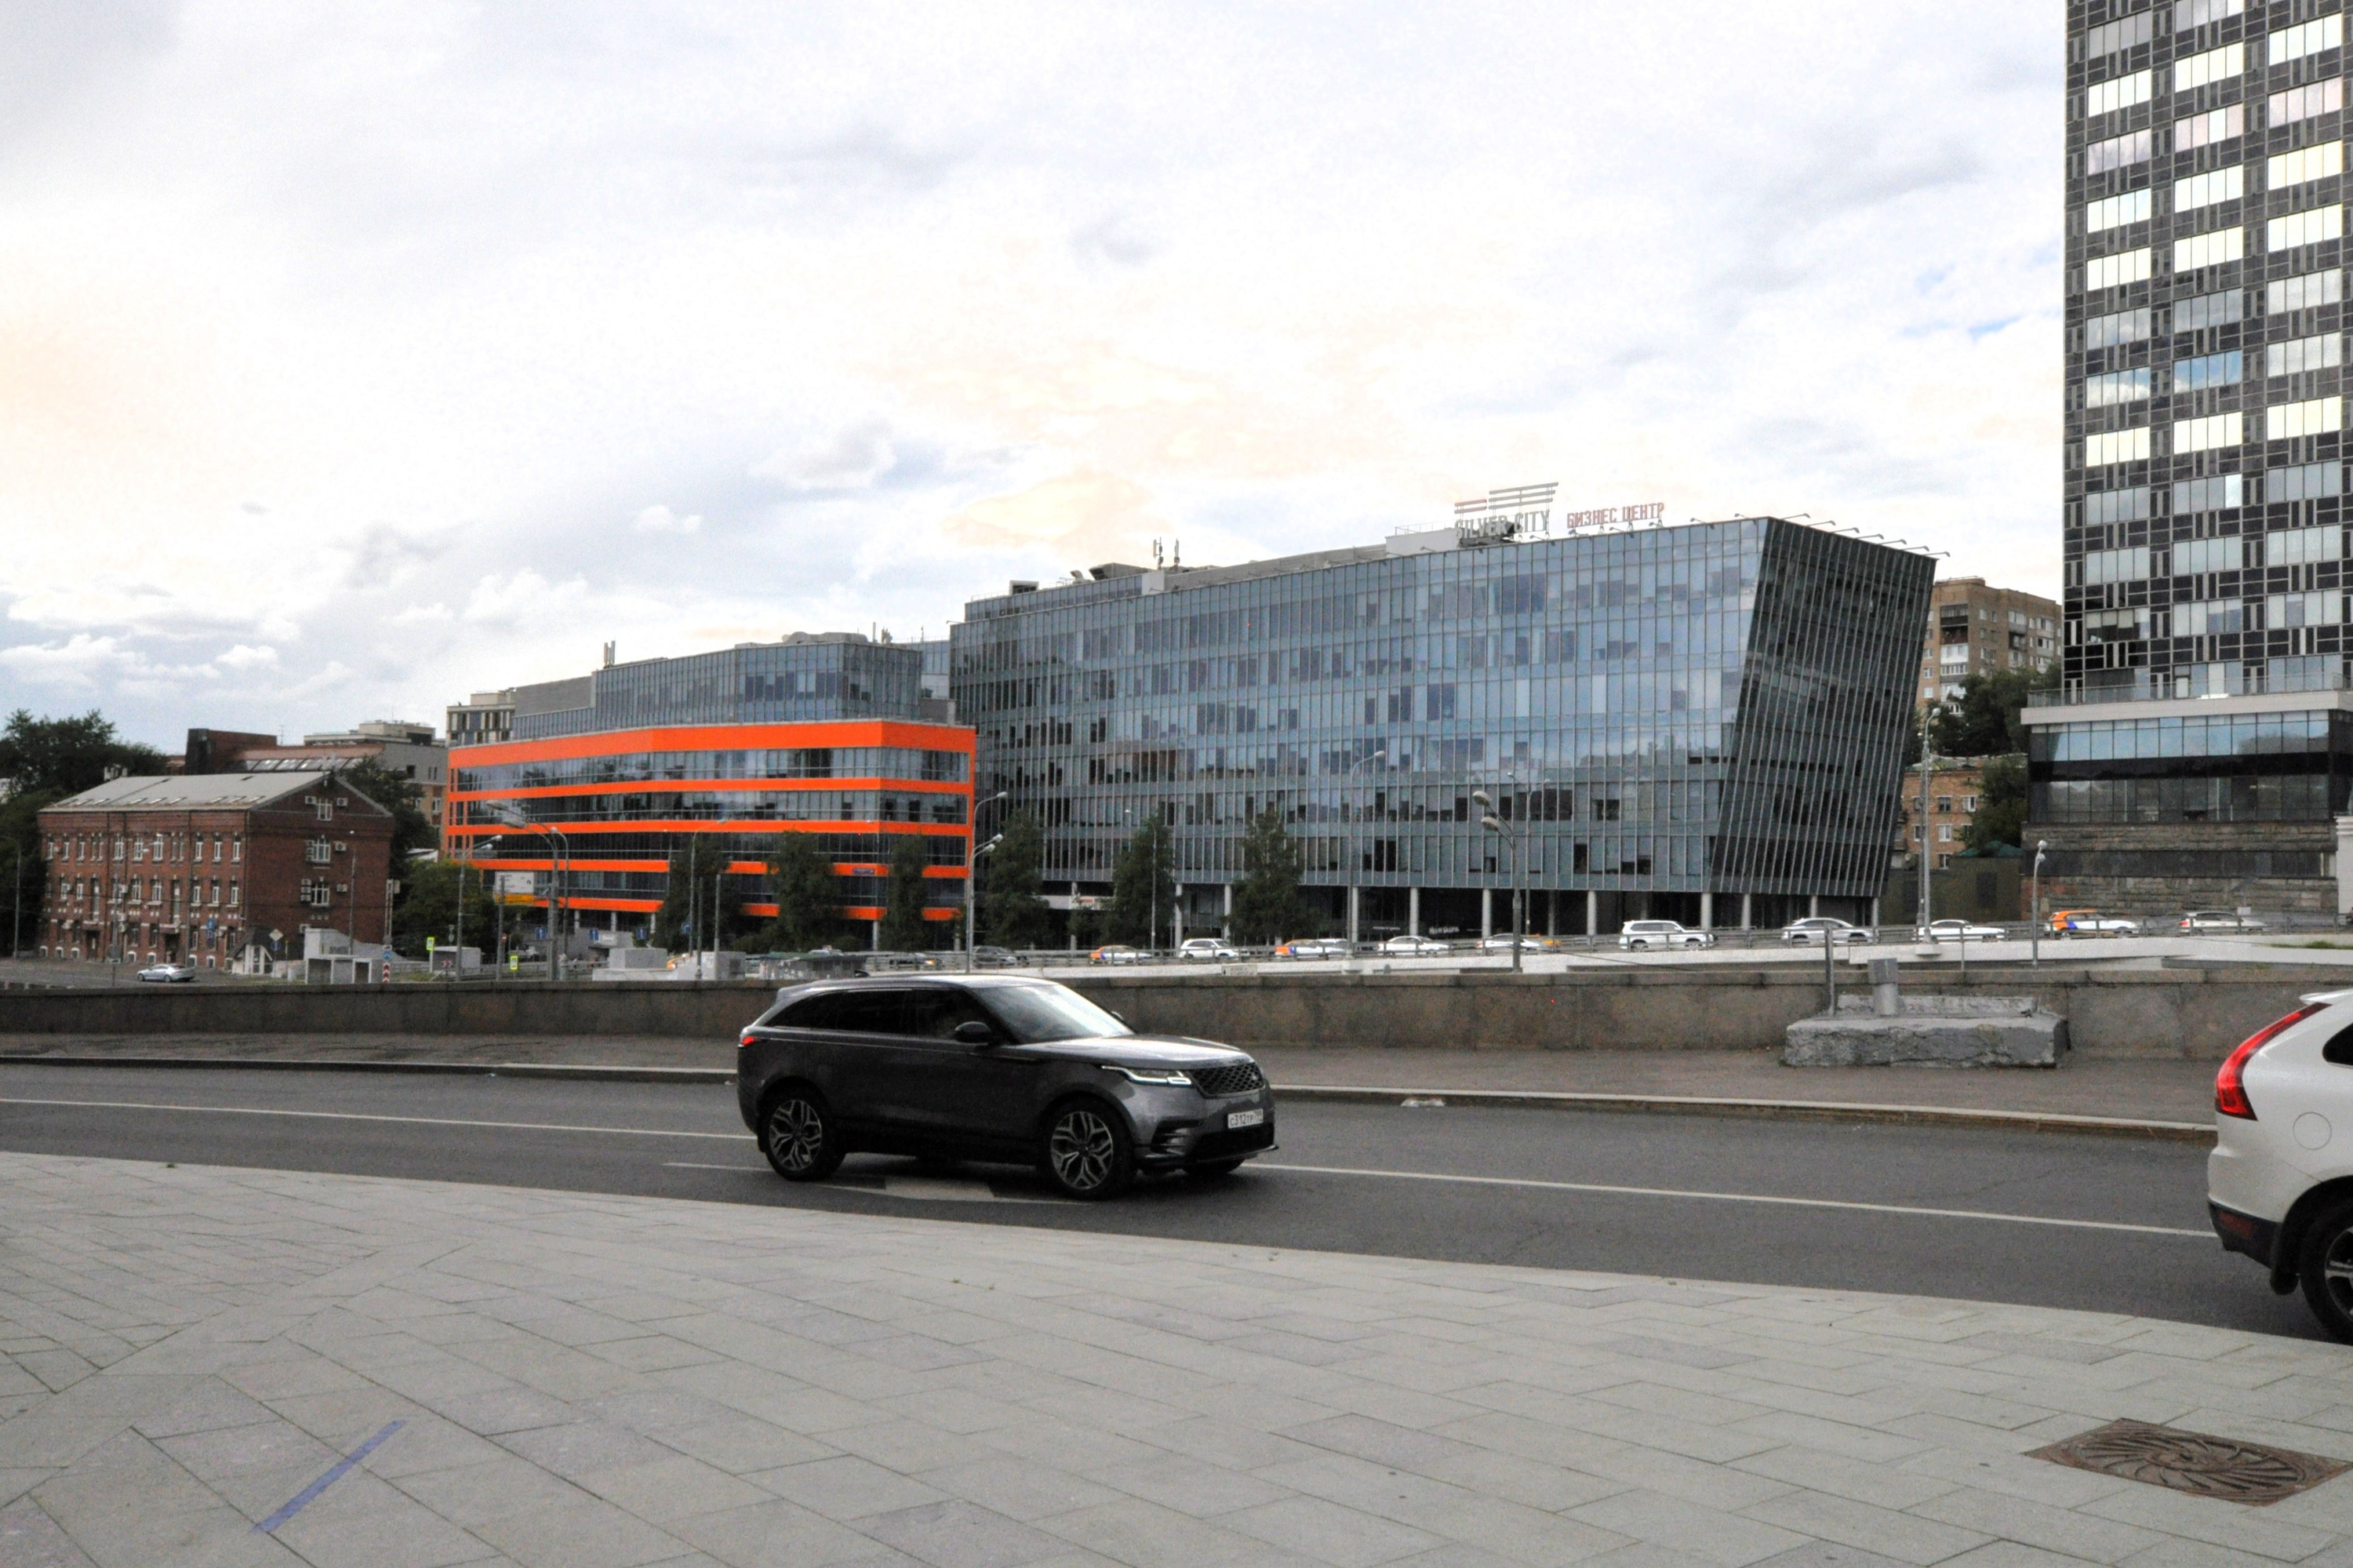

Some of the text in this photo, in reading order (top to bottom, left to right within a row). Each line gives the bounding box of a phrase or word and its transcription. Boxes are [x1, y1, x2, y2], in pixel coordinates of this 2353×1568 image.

[1454, 510, 1550, 540] SILVER CITY
[1567, 502, 1664, 529] БИЗНЕС ЦЕНТР
